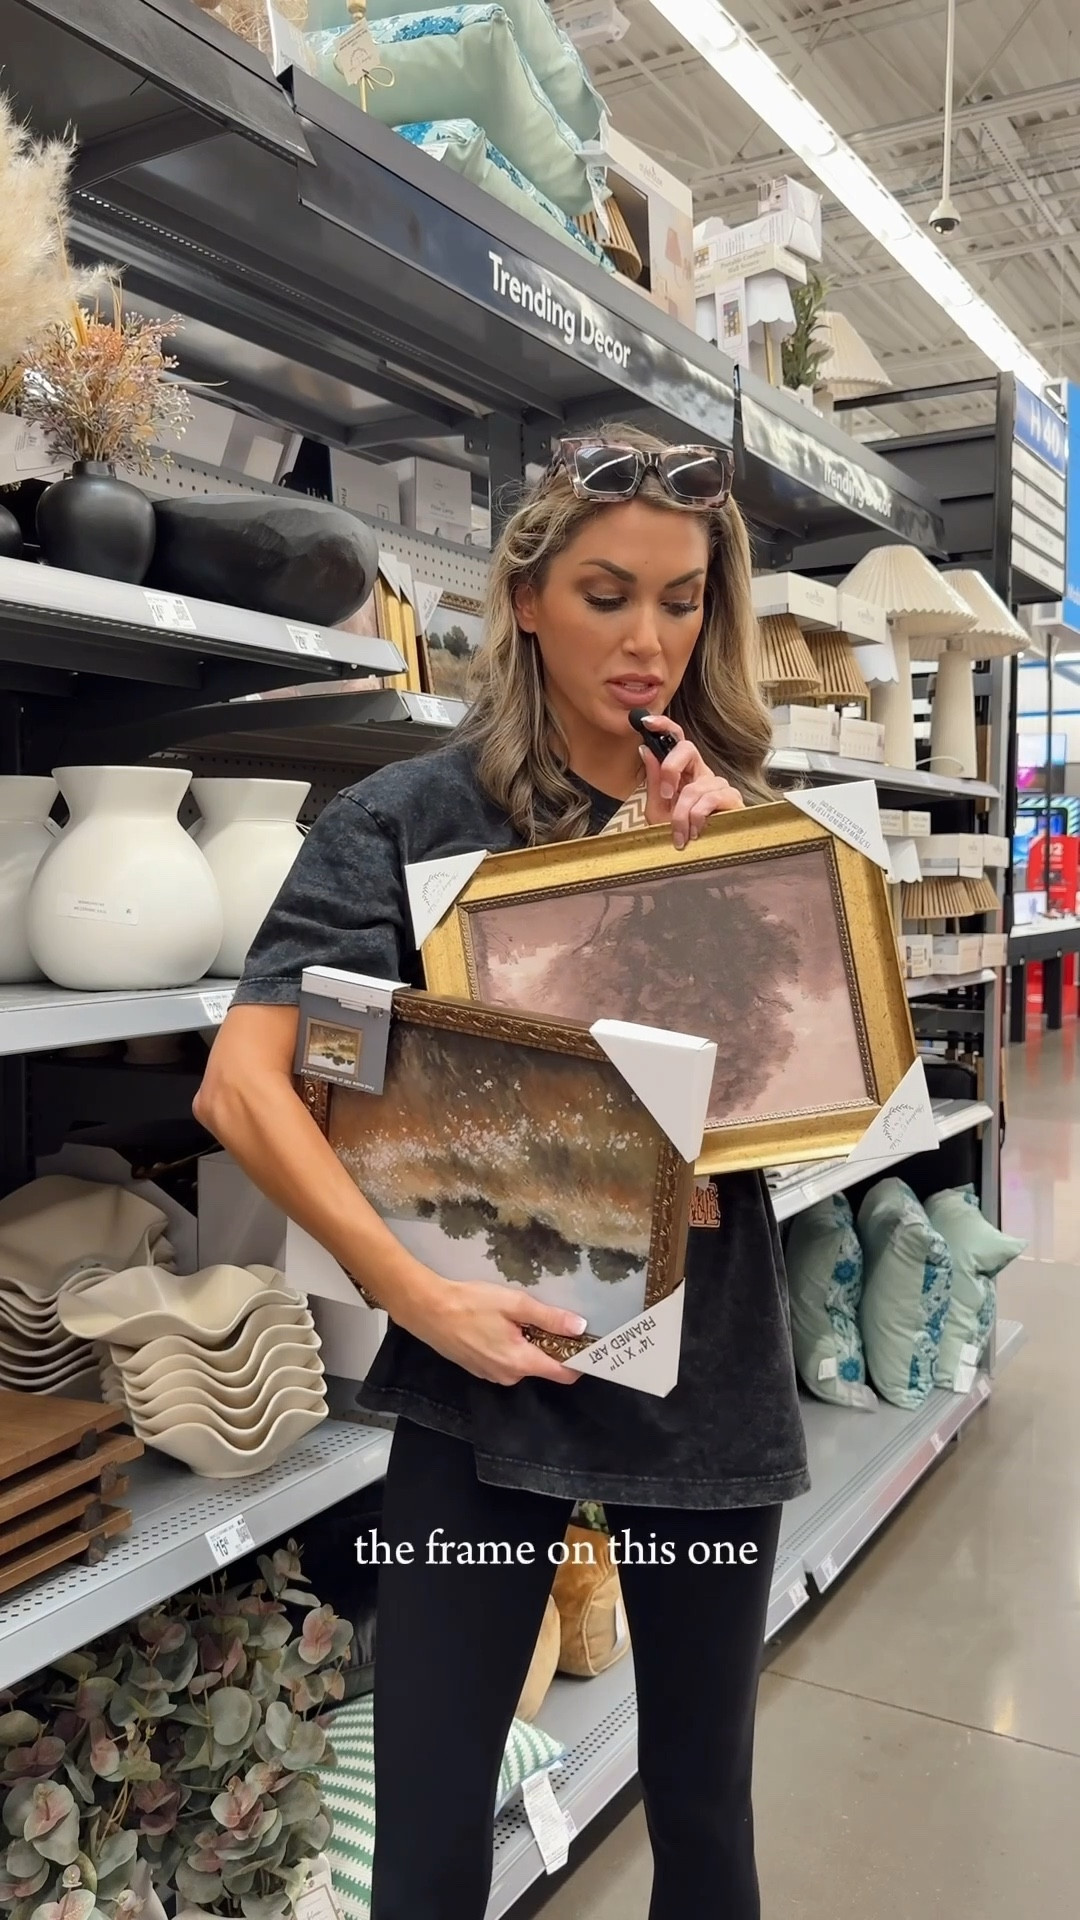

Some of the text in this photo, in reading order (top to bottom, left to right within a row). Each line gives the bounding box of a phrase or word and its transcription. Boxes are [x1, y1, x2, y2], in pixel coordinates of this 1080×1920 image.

[488, 250, 631, 368] Trending Decor
[1029, 401, 1061, 459] H 40
[823, 460, 865, 508] Trending
[588, 1315, 657, 1364] FRAMED ART
[610, 1335, 655, 1371] 14" X 11"
